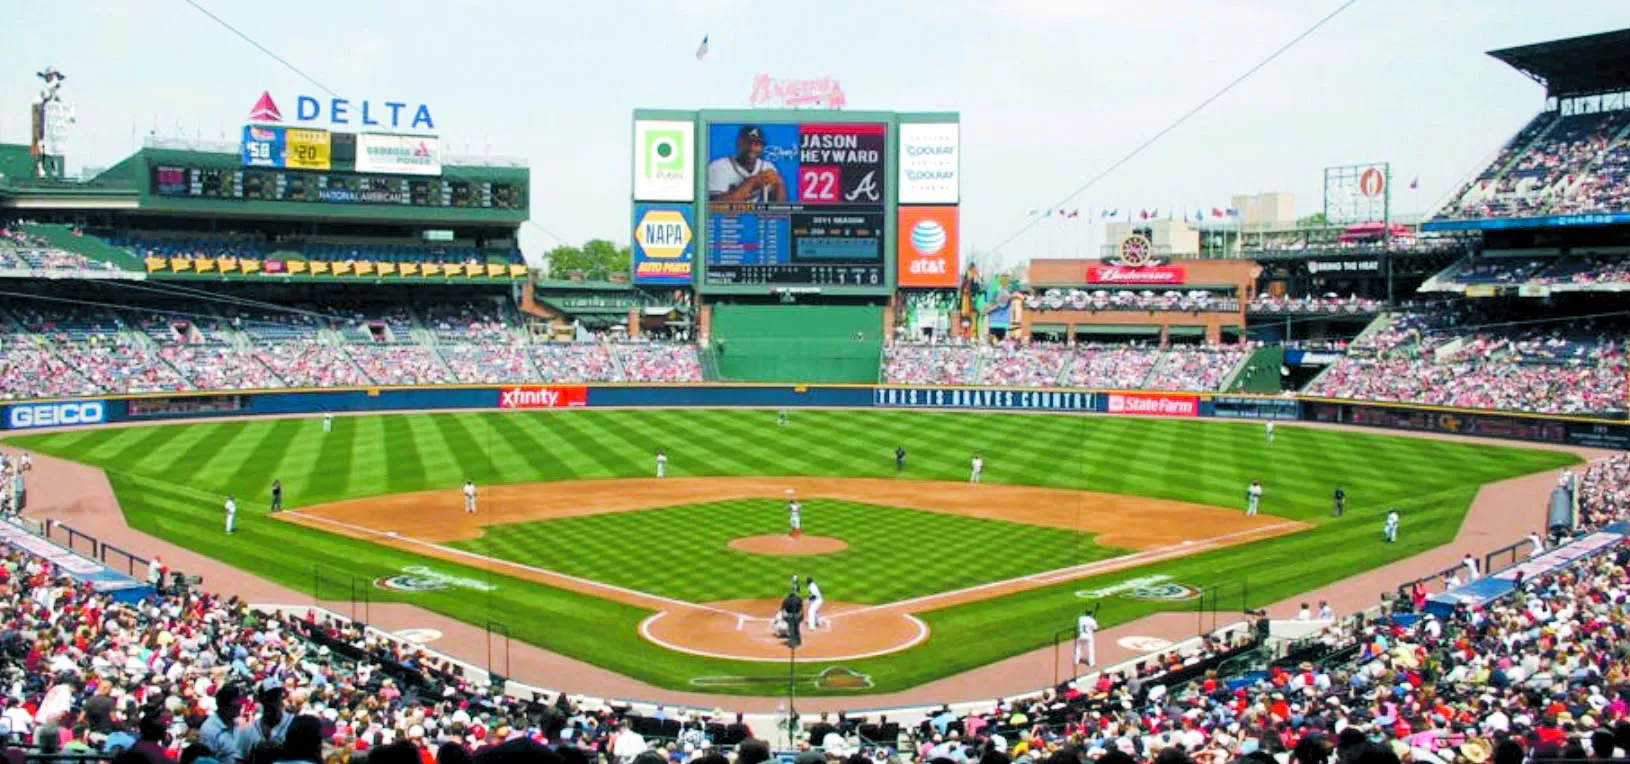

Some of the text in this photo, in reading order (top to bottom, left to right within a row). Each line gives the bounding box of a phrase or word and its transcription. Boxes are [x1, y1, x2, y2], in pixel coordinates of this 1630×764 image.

[297, 95, 434, 128] DELTA
[800, 135, 857, 149] JASON
[800, 150, 878, 163] HEYWARD
[803, 171, 834, 199] 22
[645, 223, 682, 245] NAPA
[910, 258, 946, 274] at&t
[1096, 268, 1174, 281] Budweiser
[1343, 261, 1357, 270] THE
[502, 387, 559, 408] xfinity
[879, 389, 1092, 408] THIS IS BRAVES COUNTRY
[11, 402, 103, 427] GEICO
